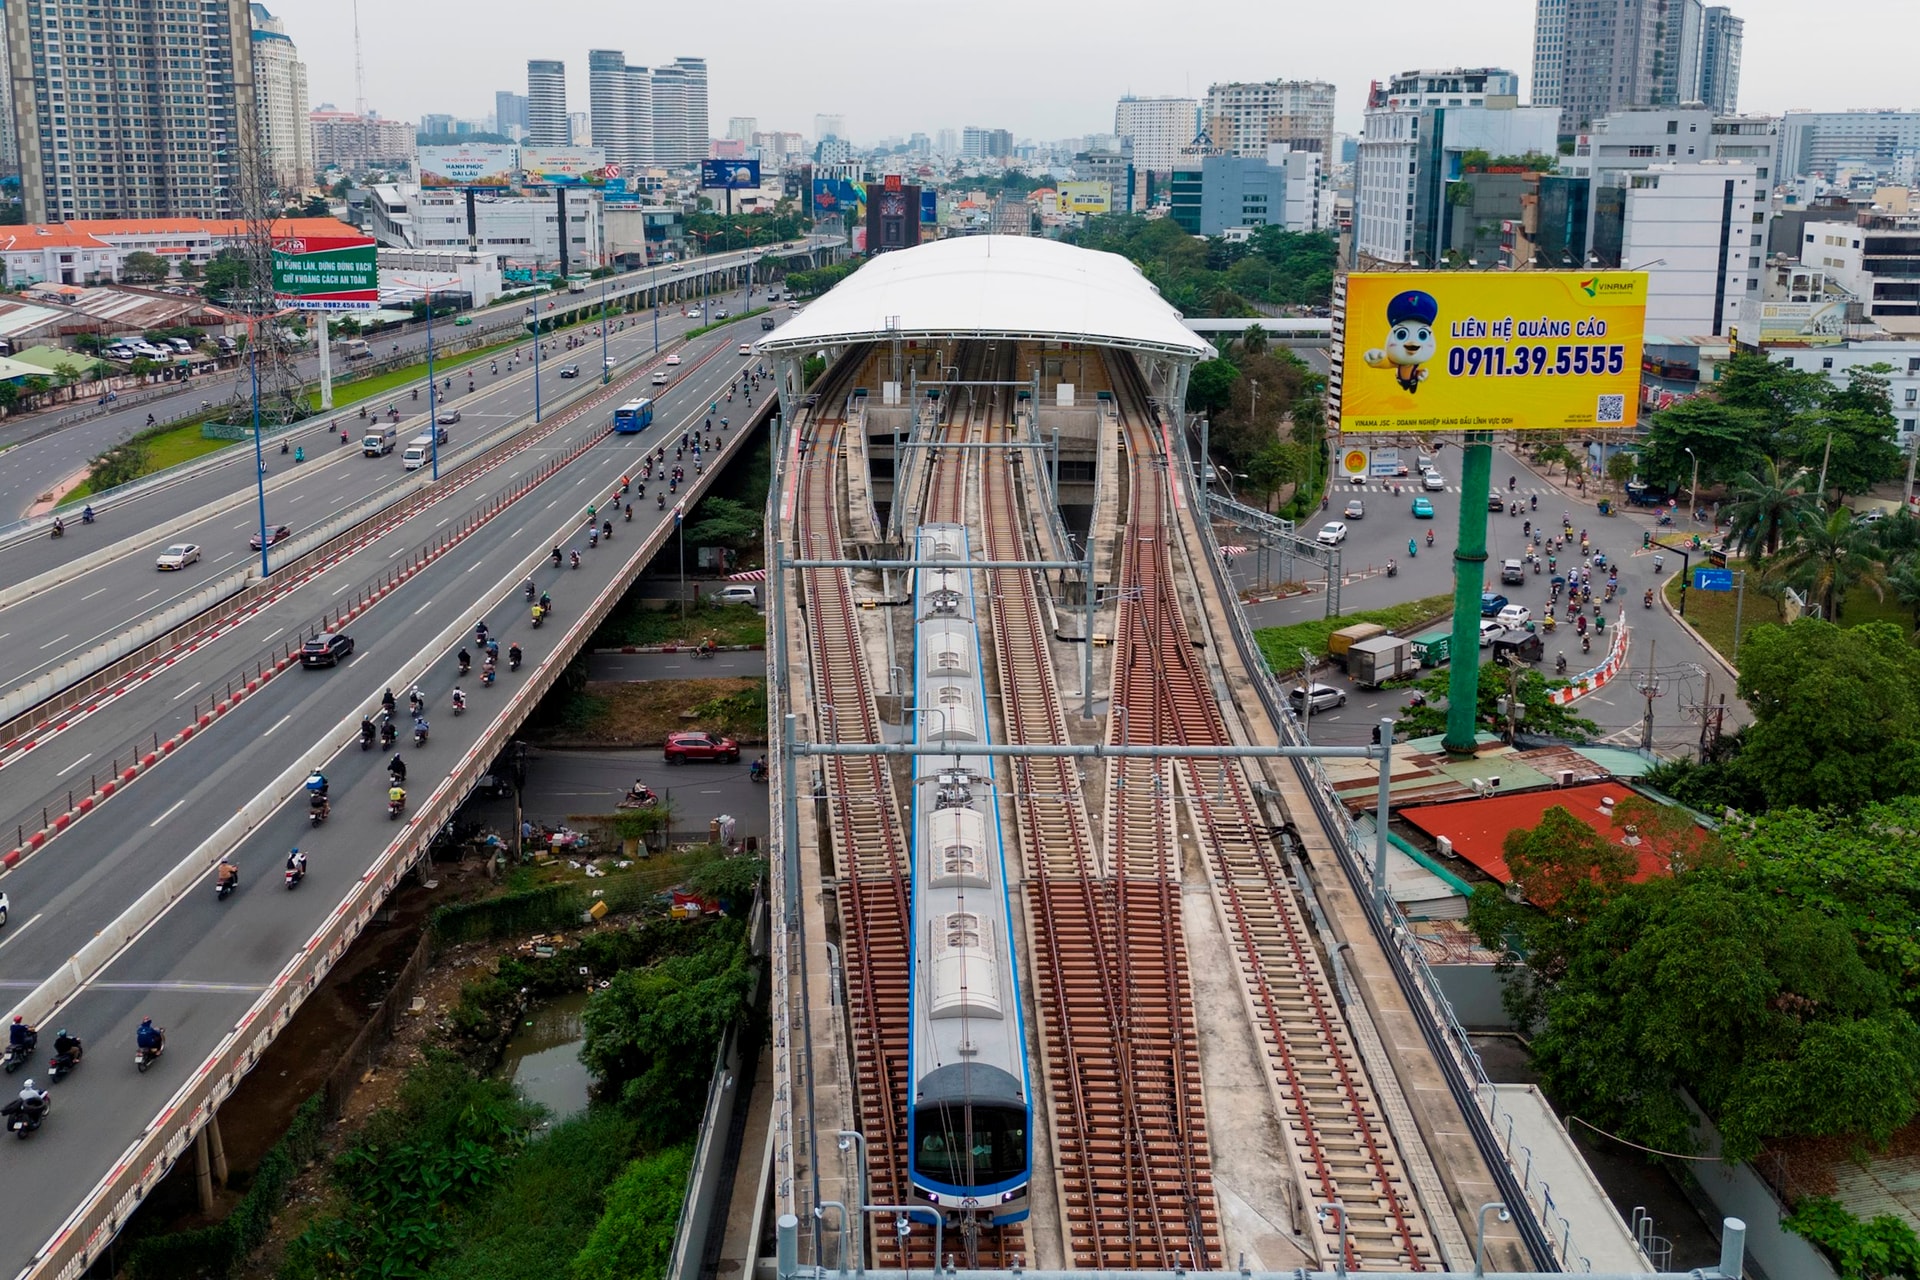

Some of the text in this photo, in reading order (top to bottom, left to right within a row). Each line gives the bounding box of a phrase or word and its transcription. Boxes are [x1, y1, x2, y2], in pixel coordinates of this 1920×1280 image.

[340, 275, 349, 284] AN
[1452, 316, 1606, 341] LIÊN HỆ QUẢNG CÁO
[1449, 345, 1624, 376] 0911.39.5555
